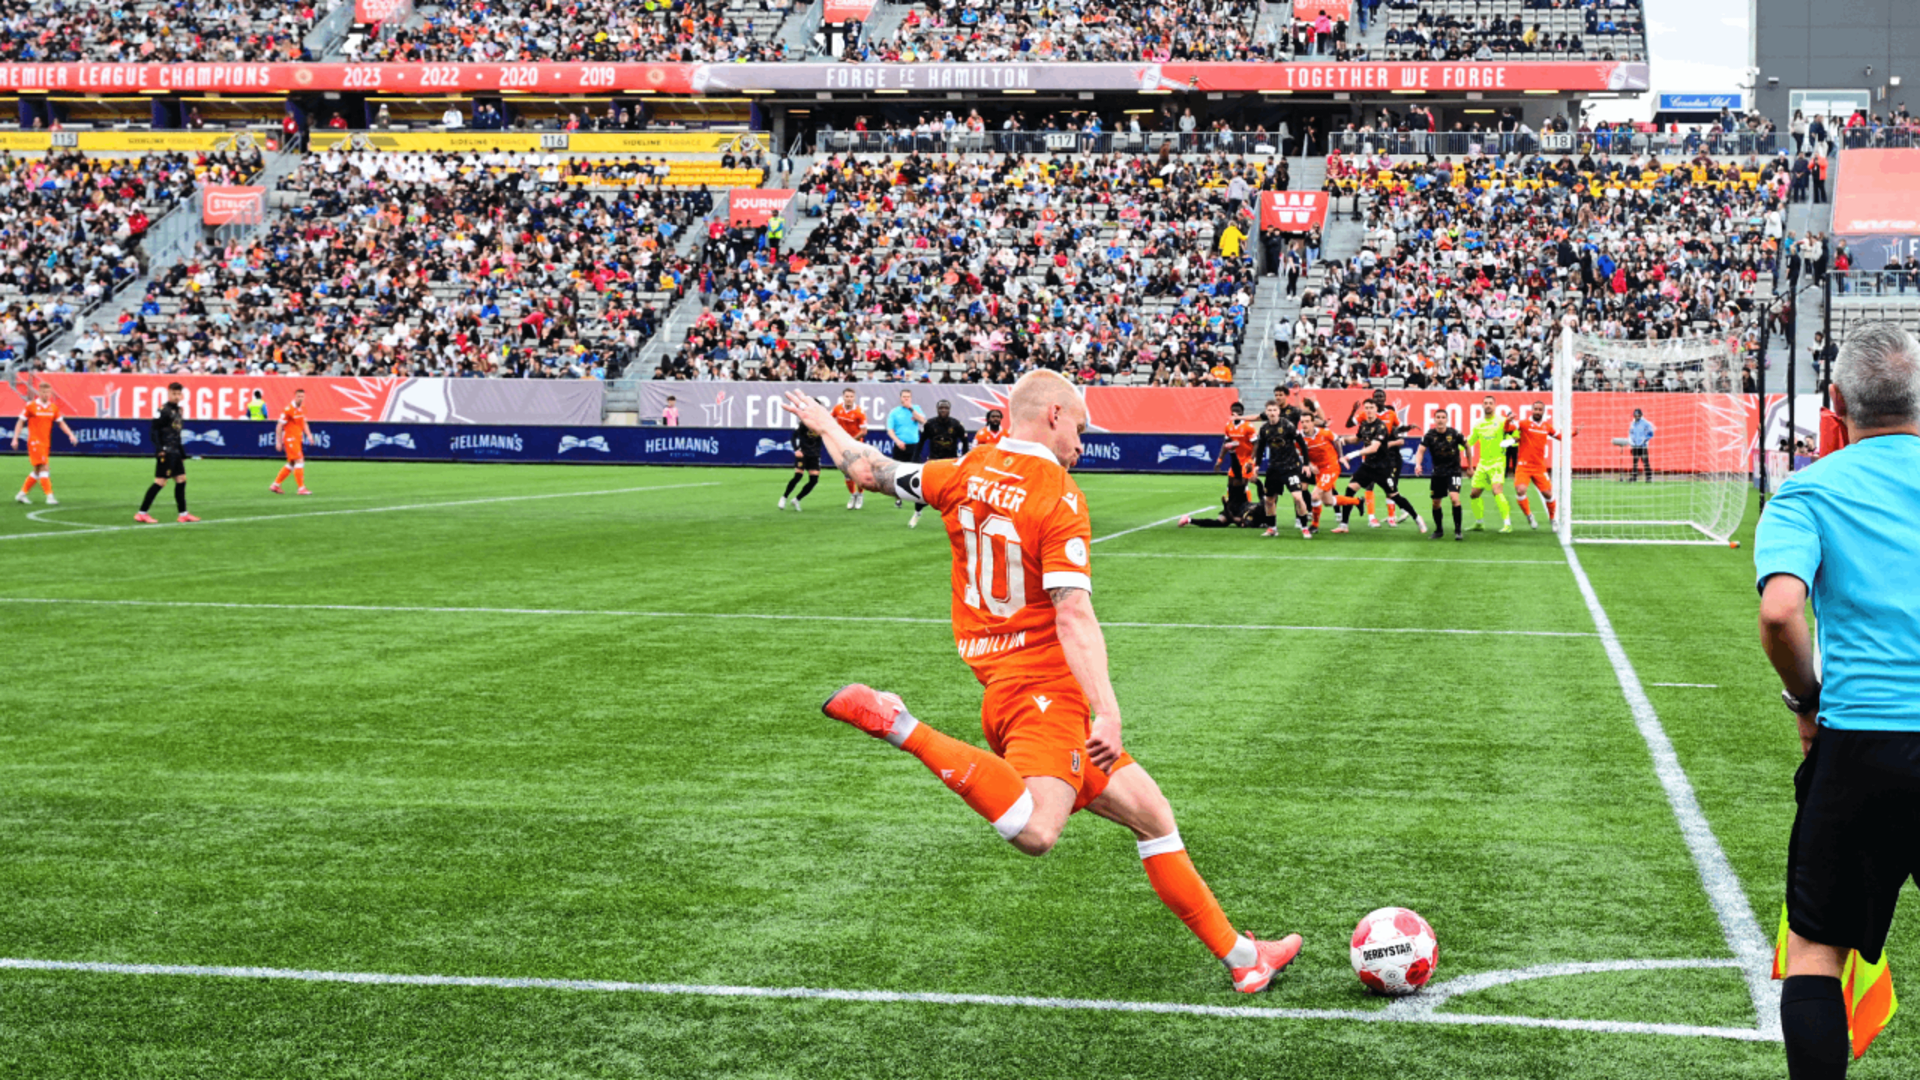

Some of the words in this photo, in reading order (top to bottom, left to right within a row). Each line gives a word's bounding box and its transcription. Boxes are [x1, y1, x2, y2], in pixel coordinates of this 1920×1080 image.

[79, 66, 148, 87] LEAGUE
[159, 66, 271, 88] CHAMPIONS
[342, 66, 382, 86] 2023
[420, 66, 460, 86] 2022
[499, 66, 539, 86] 2020
[579, 66, 616, 86] 2019
[826, 67, 886, 87] FORGE
[900, 67, 915, 82] FC
[928, 67, 1029, 88] HAMILTON
[1285, 67, 1388, 88] TOGETHER
[1401, 67, 1430, 88] WE
[1443, 67, 1506, 88] FORGE
[53, 133, 75, 145] 115
[543, 135, 564, 147] 116
[1050, 135, 1072, 146] 117
[1545, 135, 1568, 147] 118
[450, 432, 523, 452] HELLMANN'S
[645, 436, 719, 455] HELLMANN'S
[1081, 442, 1121, 461] ANN'S
[1452, 476, 1462, 486] 10
[958, 504, 1027, 619] 10
[957, 630, 1027, 659] HAMILTON
[1363, 943, 1413, 961] DERBYSTAR
